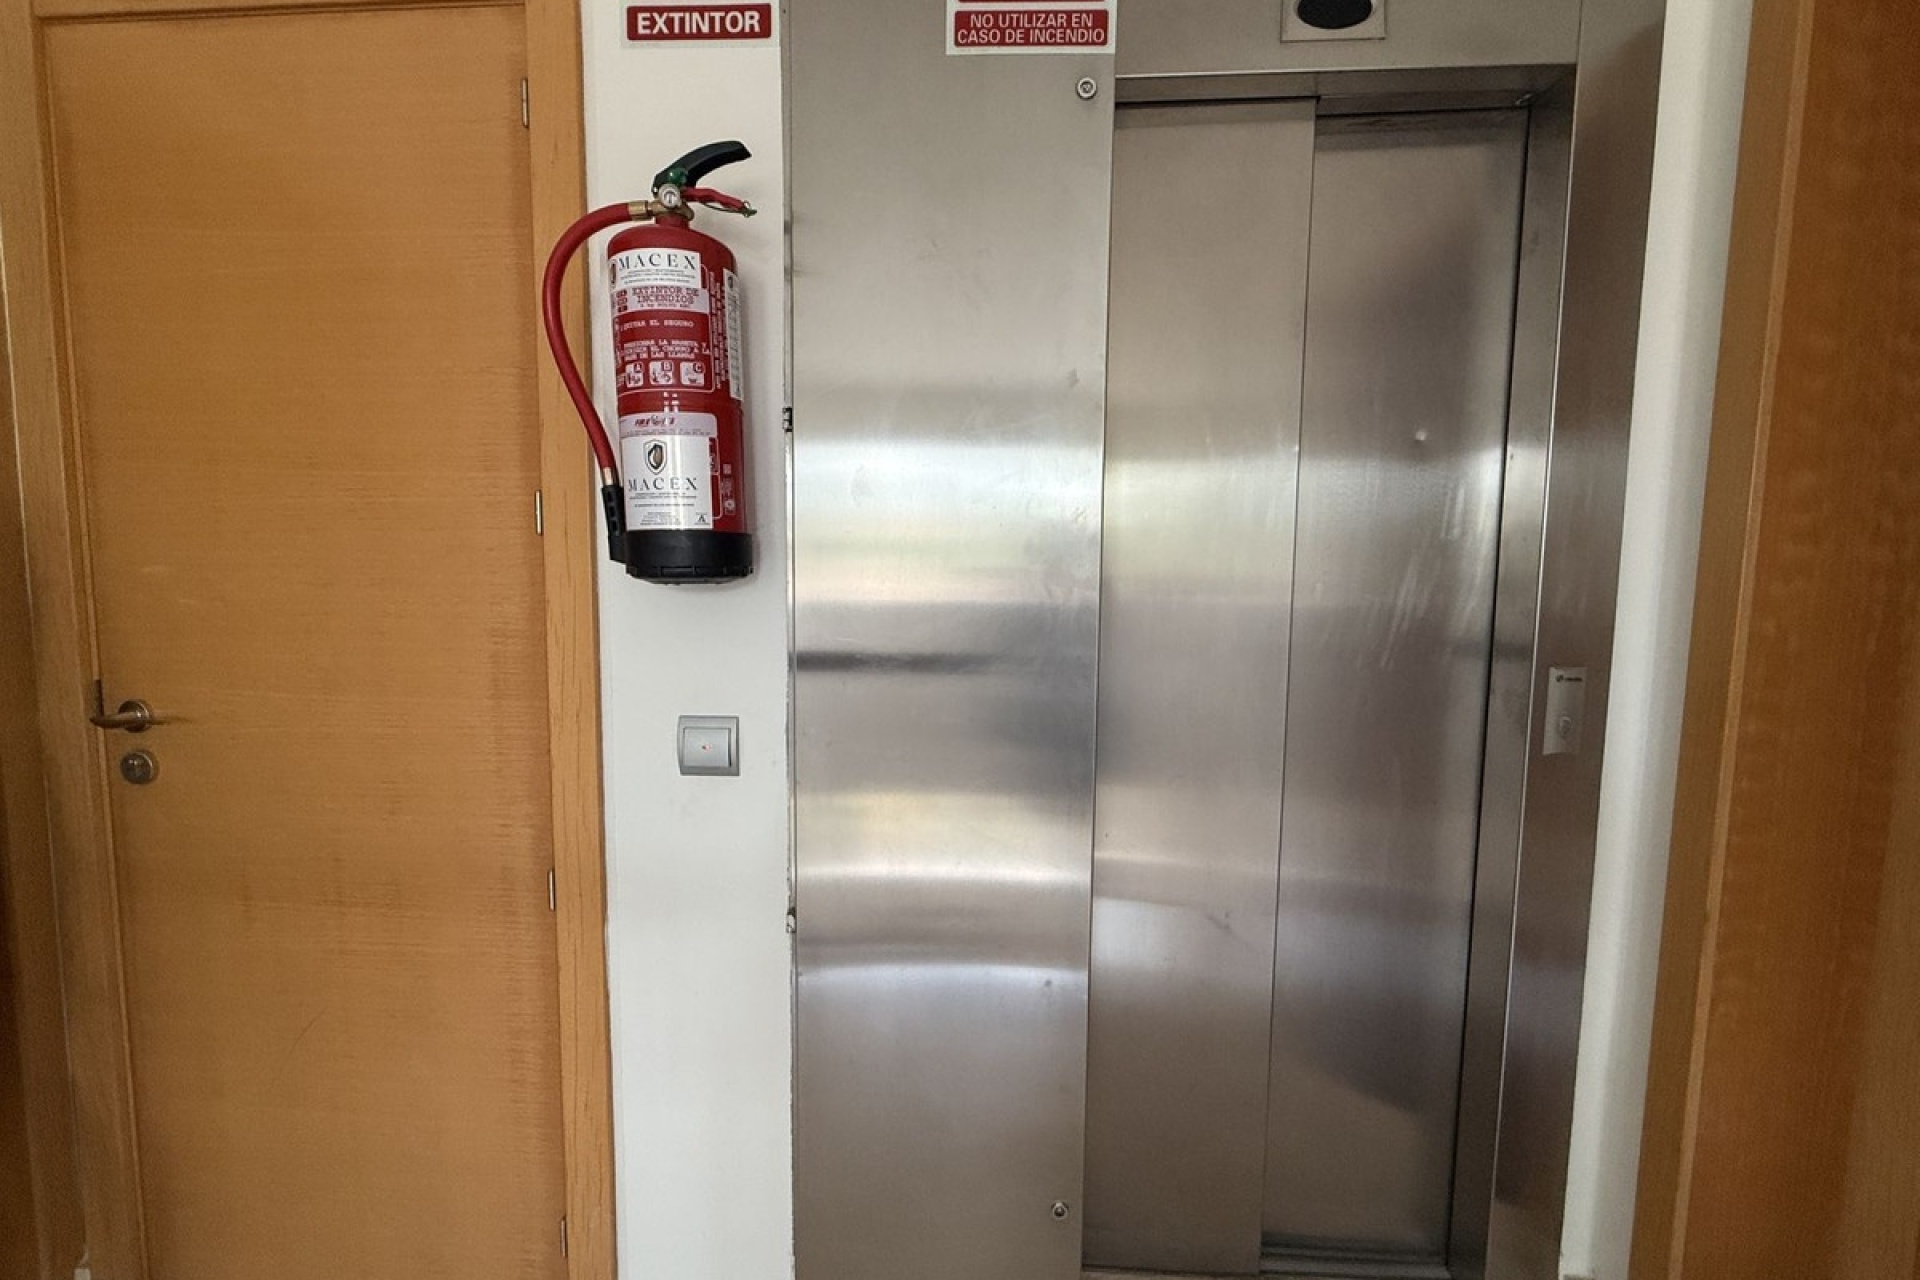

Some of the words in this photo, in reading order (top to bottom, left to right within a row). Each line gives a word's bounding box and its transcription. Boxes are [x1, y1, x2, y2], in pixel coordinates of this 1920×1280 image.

[637, 10, 761, 35] EXTINTOR
[970, 13, 994, 28] NO
[999, 13, 1067, 28] UTILIZAR
[1071, 13, 1093, 28] EN
[957, 29, 1001, 44] CASO
[1005, 29, 1025, 43] DE
[1029, 28, 1105, 43] INCENDIO
[618, 253, 697, 270] MACEX
[632, 286, 682, 296] EXTINTOR
[637, 294, 694, 304] INCENDIOS
[628, 477, 698, 491] MACEX
